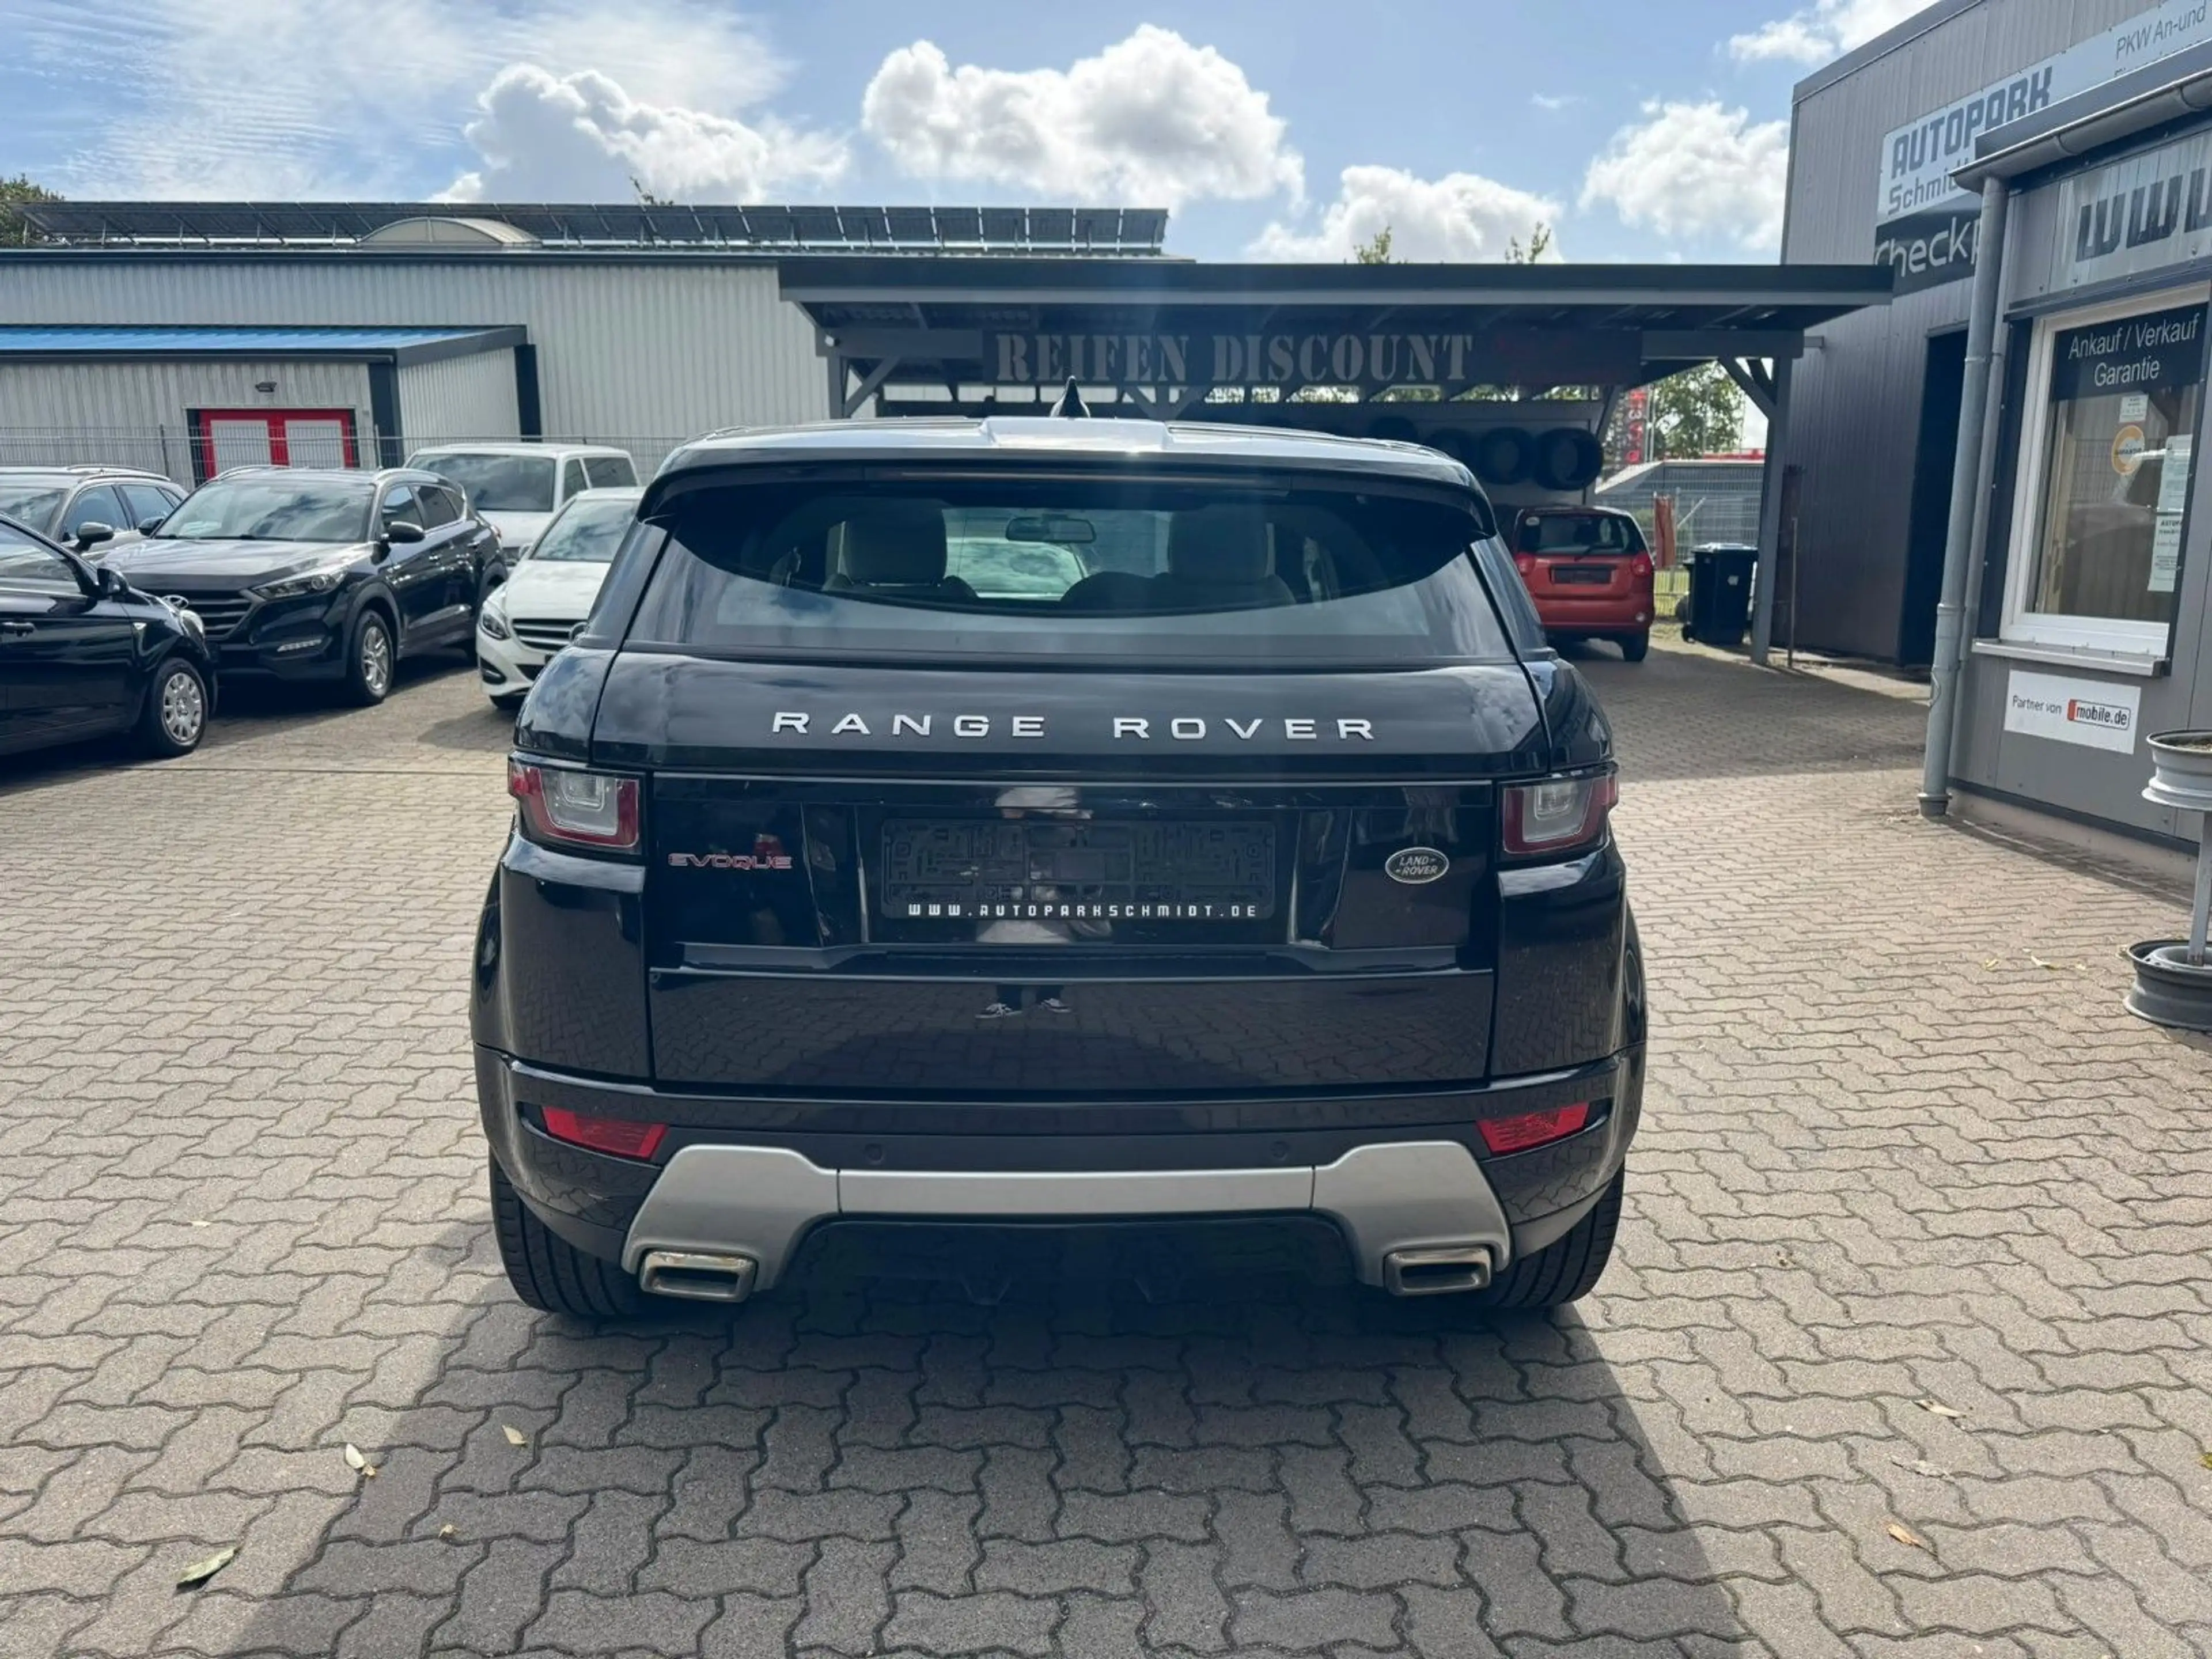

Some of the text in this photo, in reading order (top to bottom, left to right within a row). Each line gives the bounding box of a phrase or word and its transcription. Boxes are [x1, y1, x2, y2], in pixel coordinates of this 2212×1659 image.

[2116, 24, 2152, 60] PKW
[1891, 66, 2053, 180] AUTOPARK
[1887, 157, 1969, 216] Schmi
[2068, 327, 2123, 359] Ankauf
[2135, 313, 2199, 348] Verkauf
[996, 334, 1472, 382] REIFEN DISCOUNT
[2094, 355, 2161, 387] Garantie
[2013, 695, 2062, 714] Partner von
[2076, 704, 2127, 726] mobile.de
[772, 711, 1374, 741] RANGE ROVER
[668, 853, 793, 870] EVOQUE
[908, 904, 1256, 917] WWW.AUTOPARKSCHMIDT.DE
